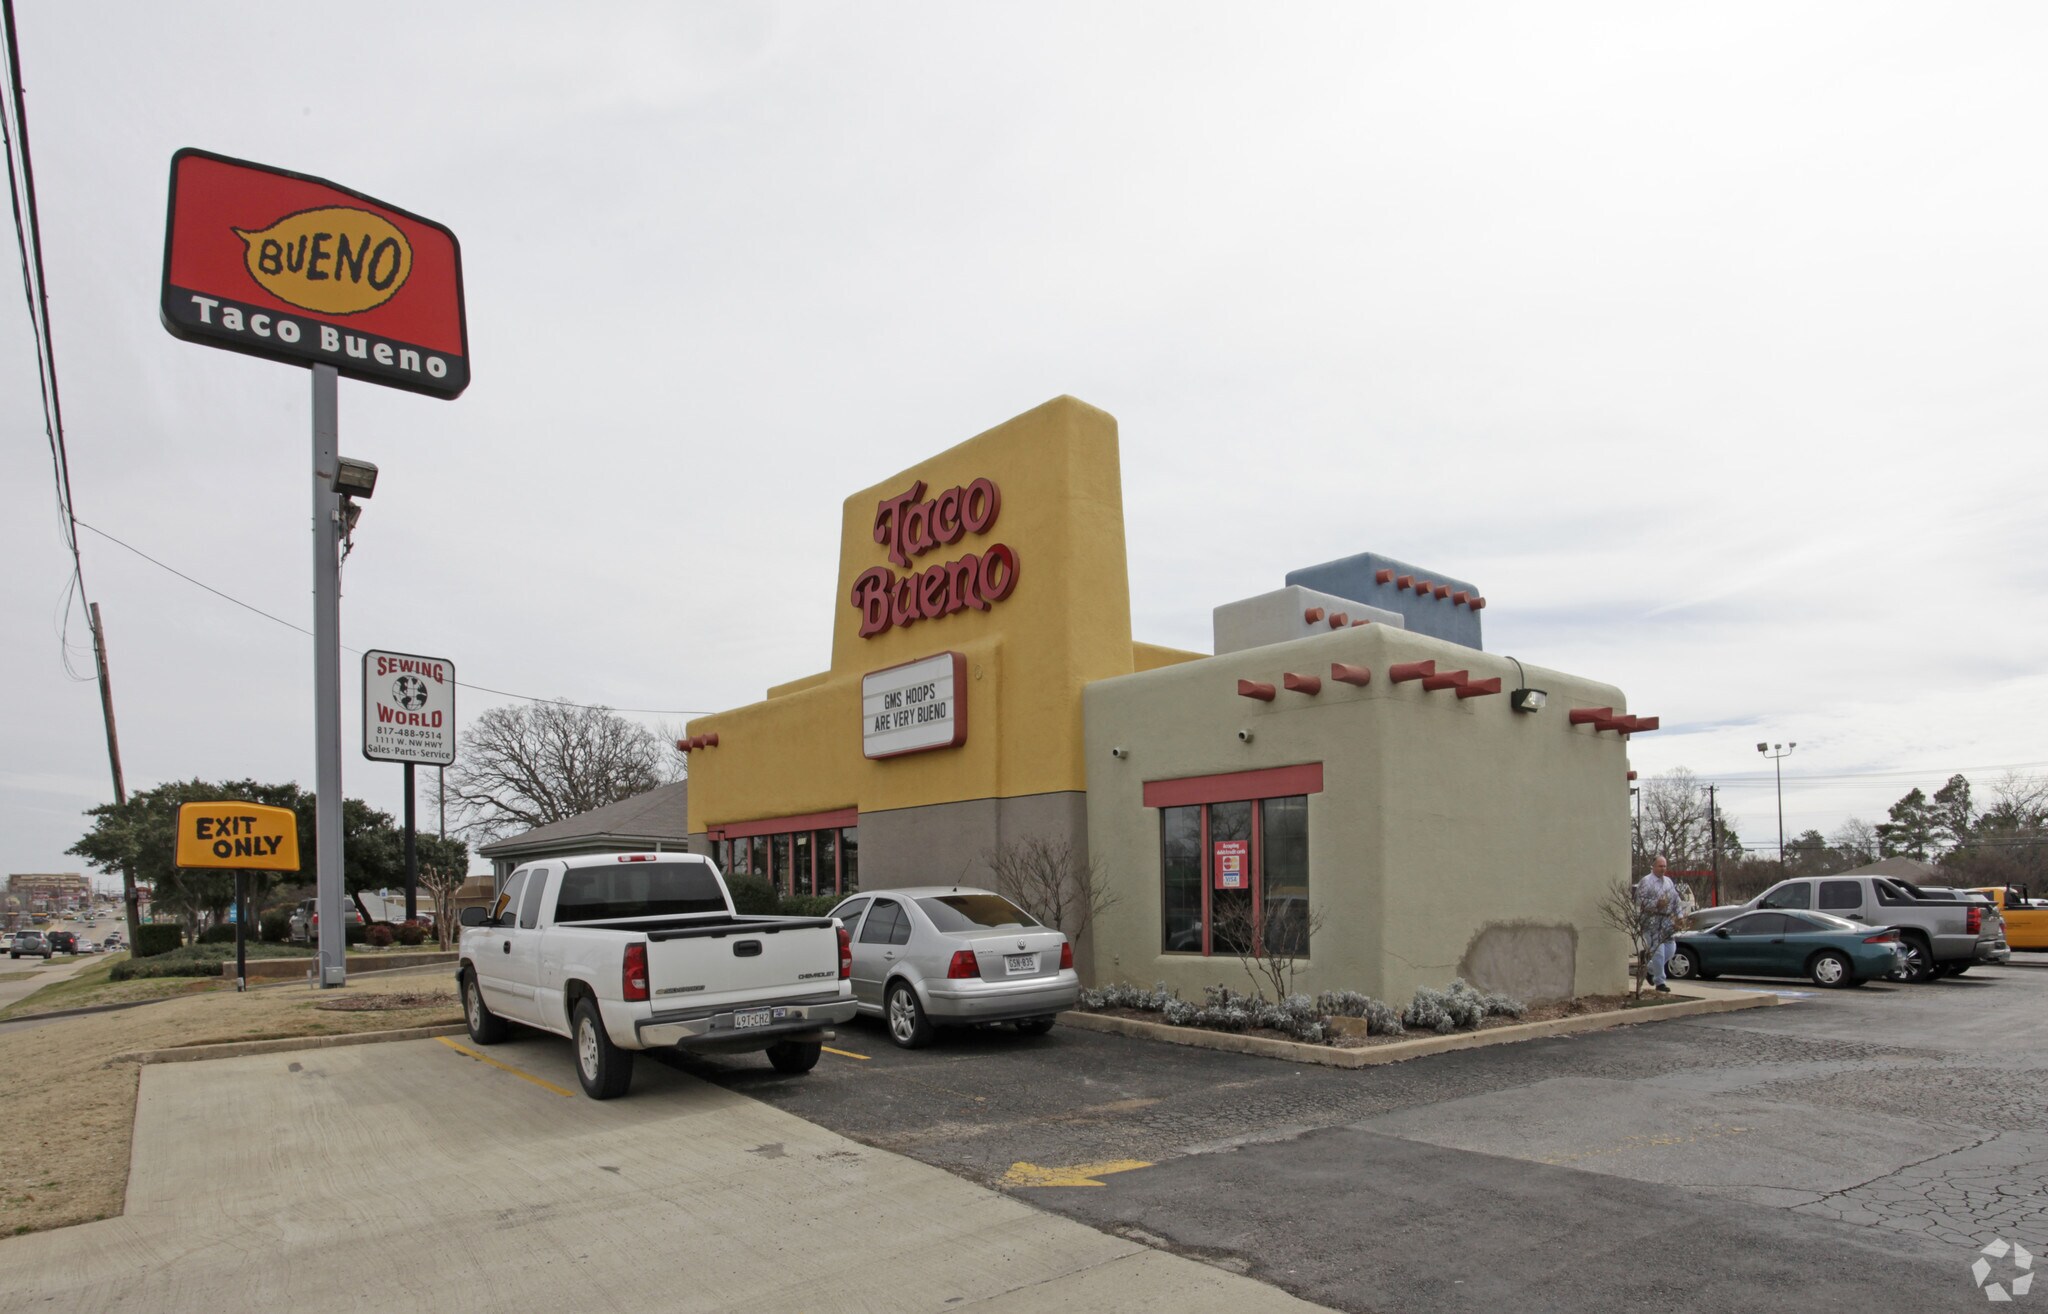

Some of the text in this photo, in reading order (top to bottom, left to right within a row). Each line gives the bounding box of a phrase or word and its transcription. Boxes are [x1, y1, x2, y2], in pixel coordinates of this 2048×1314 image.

[258, 233, 402, 291] BUENO
[191, 295, 447, 378] Taco Bueno
[851, 477, 1021, 640] Taco Bueno
[377, 656, 443, 685] SEWING
[884, 683, 936, 710] GMS HOOPS
[377, 702, 443, 728] WORLD
[874, 702, 947, 732] ARE VERY BUENO
[375, 736, 394, 745] 1111
[408, 739, 423, 747] NW
[424, 741, 443, 749] HWY
[377, 726, 442, 740] 817-488-9514
[196, 816, 257, 840] EXIT
[212, 835, 283, 858] ONLY
[798, 971, 835, 980] CHEVROLET
